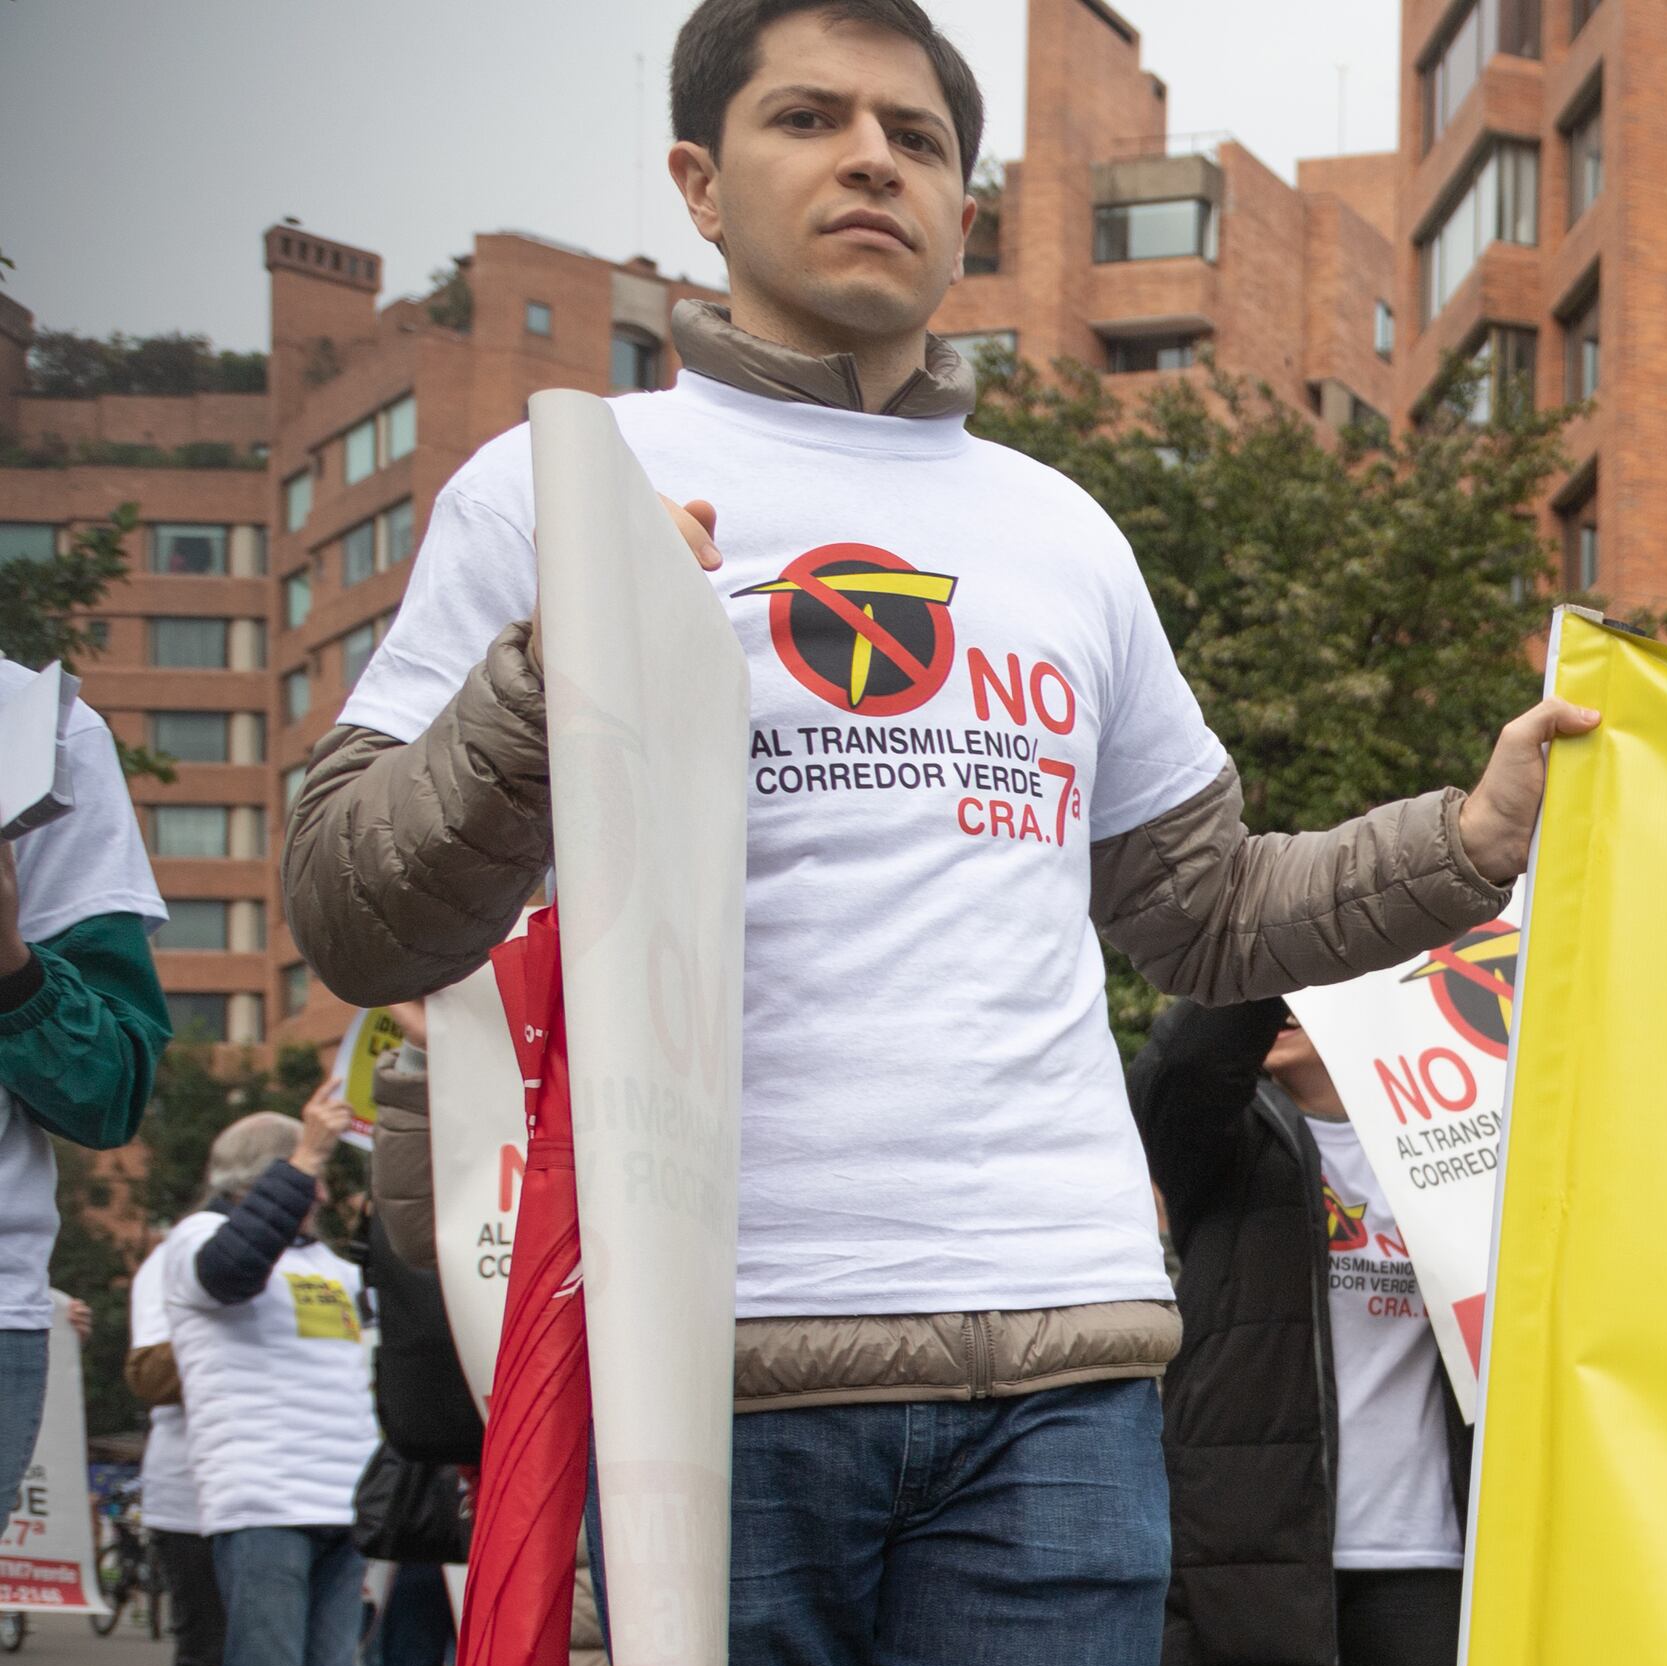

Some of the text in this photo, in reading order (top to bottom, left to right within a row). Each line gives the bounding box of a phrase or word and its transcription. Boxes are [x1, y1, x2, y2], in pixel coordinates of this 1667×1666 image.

[967, 647, 1076, 735] NO
[751, 726, 1038, 763] AL TRANSMILENIO/
[756, 762, 1043, 798] CORREDOR VERDE
[957, 796, 1051, 843] CRA.
[1373, 1046, 1478, 1125] NO
[1396, 1134, 1422, 1160] AL
[1370, 1277, 1416, 1295] VERDE
